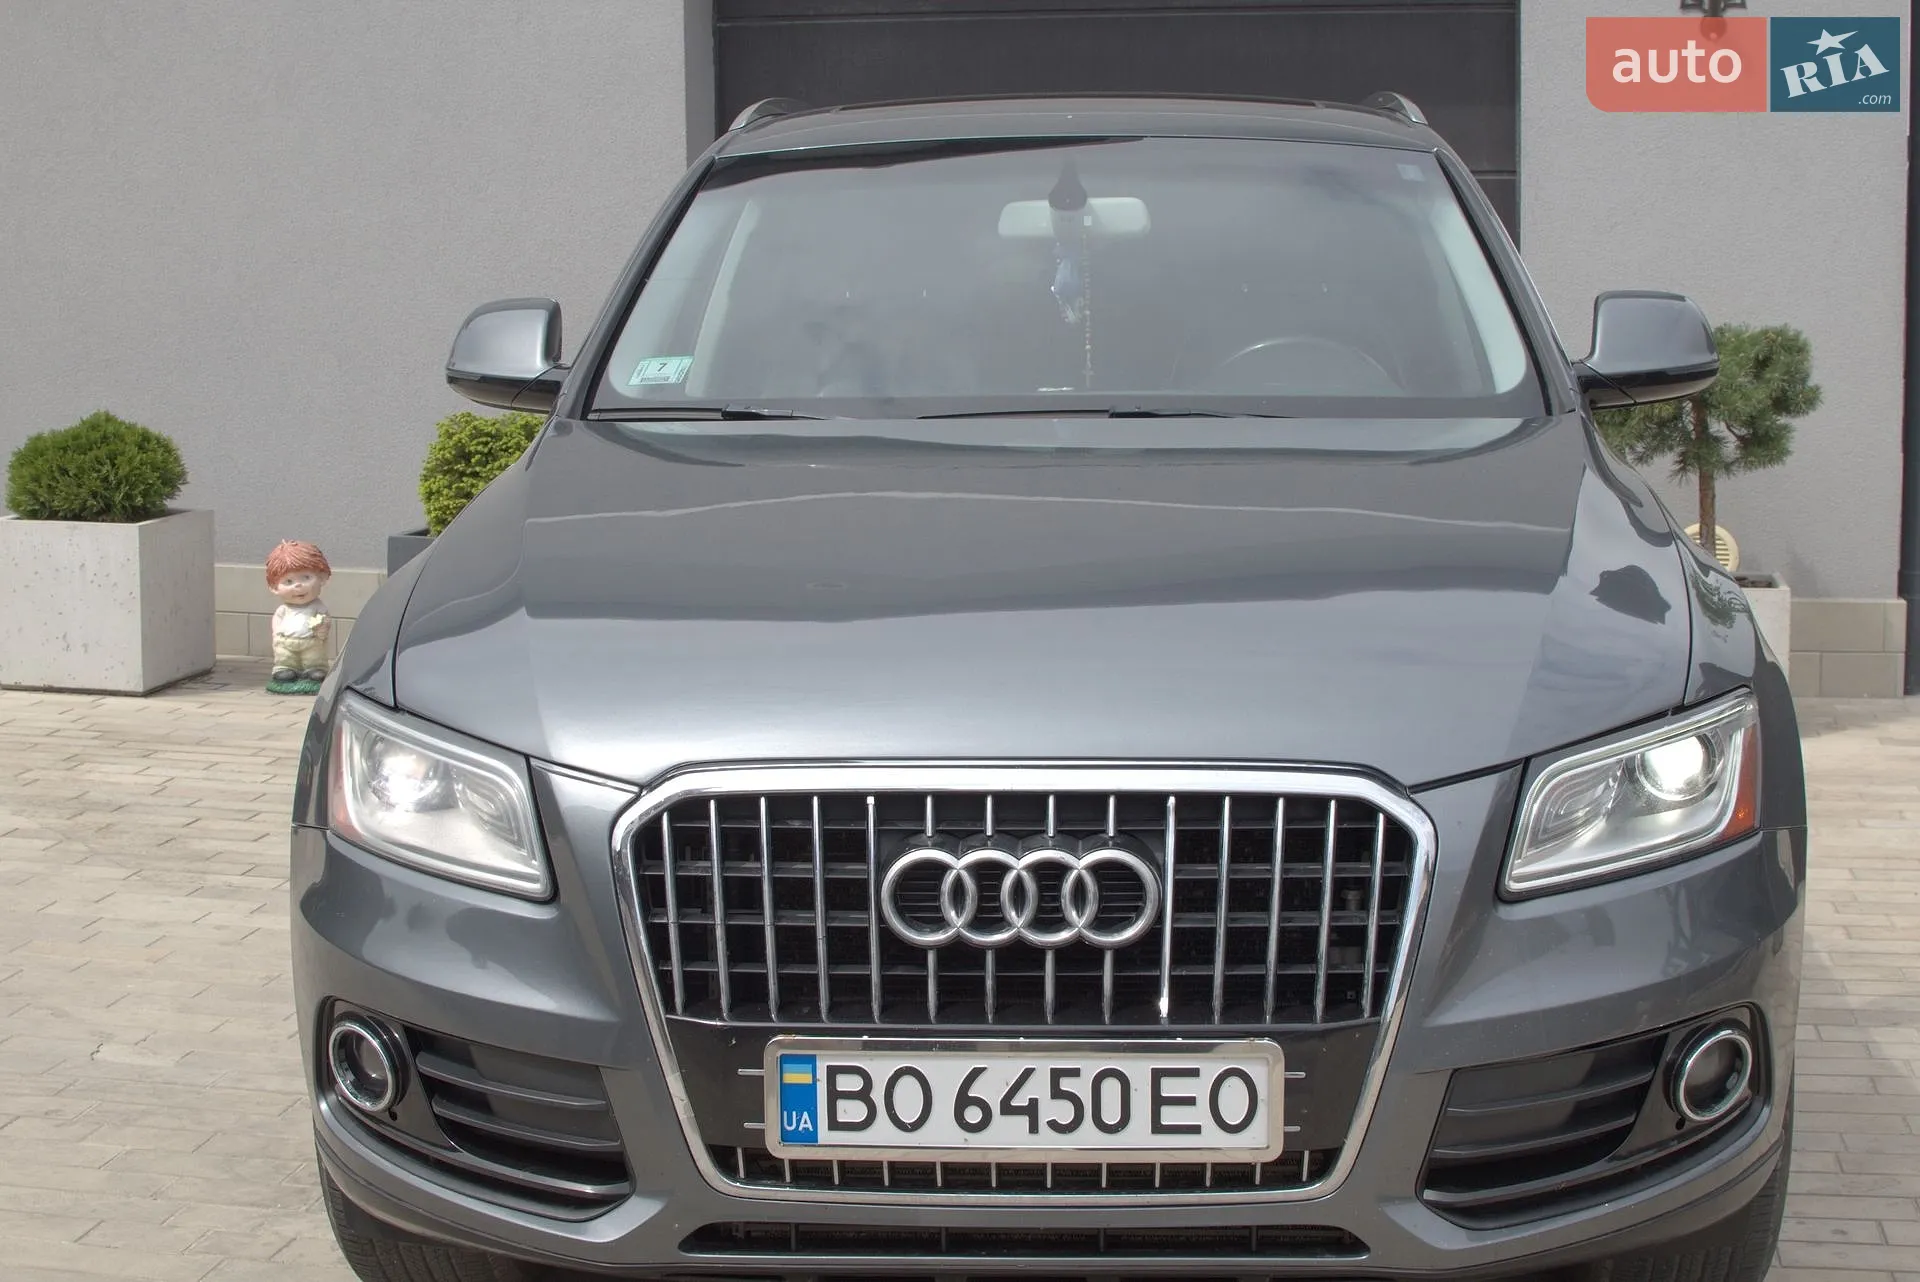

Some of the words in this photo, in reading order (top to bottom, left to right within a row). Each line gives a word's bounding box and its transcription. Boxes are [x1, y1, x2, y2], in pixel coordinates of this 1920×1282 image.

[783, 1110, 814, 1133] UA
[826, 1064, 933, 1133] BO
[953, 1065, 1131, 1134] 6450
[1150, 1065, 1259, 1134] EO
